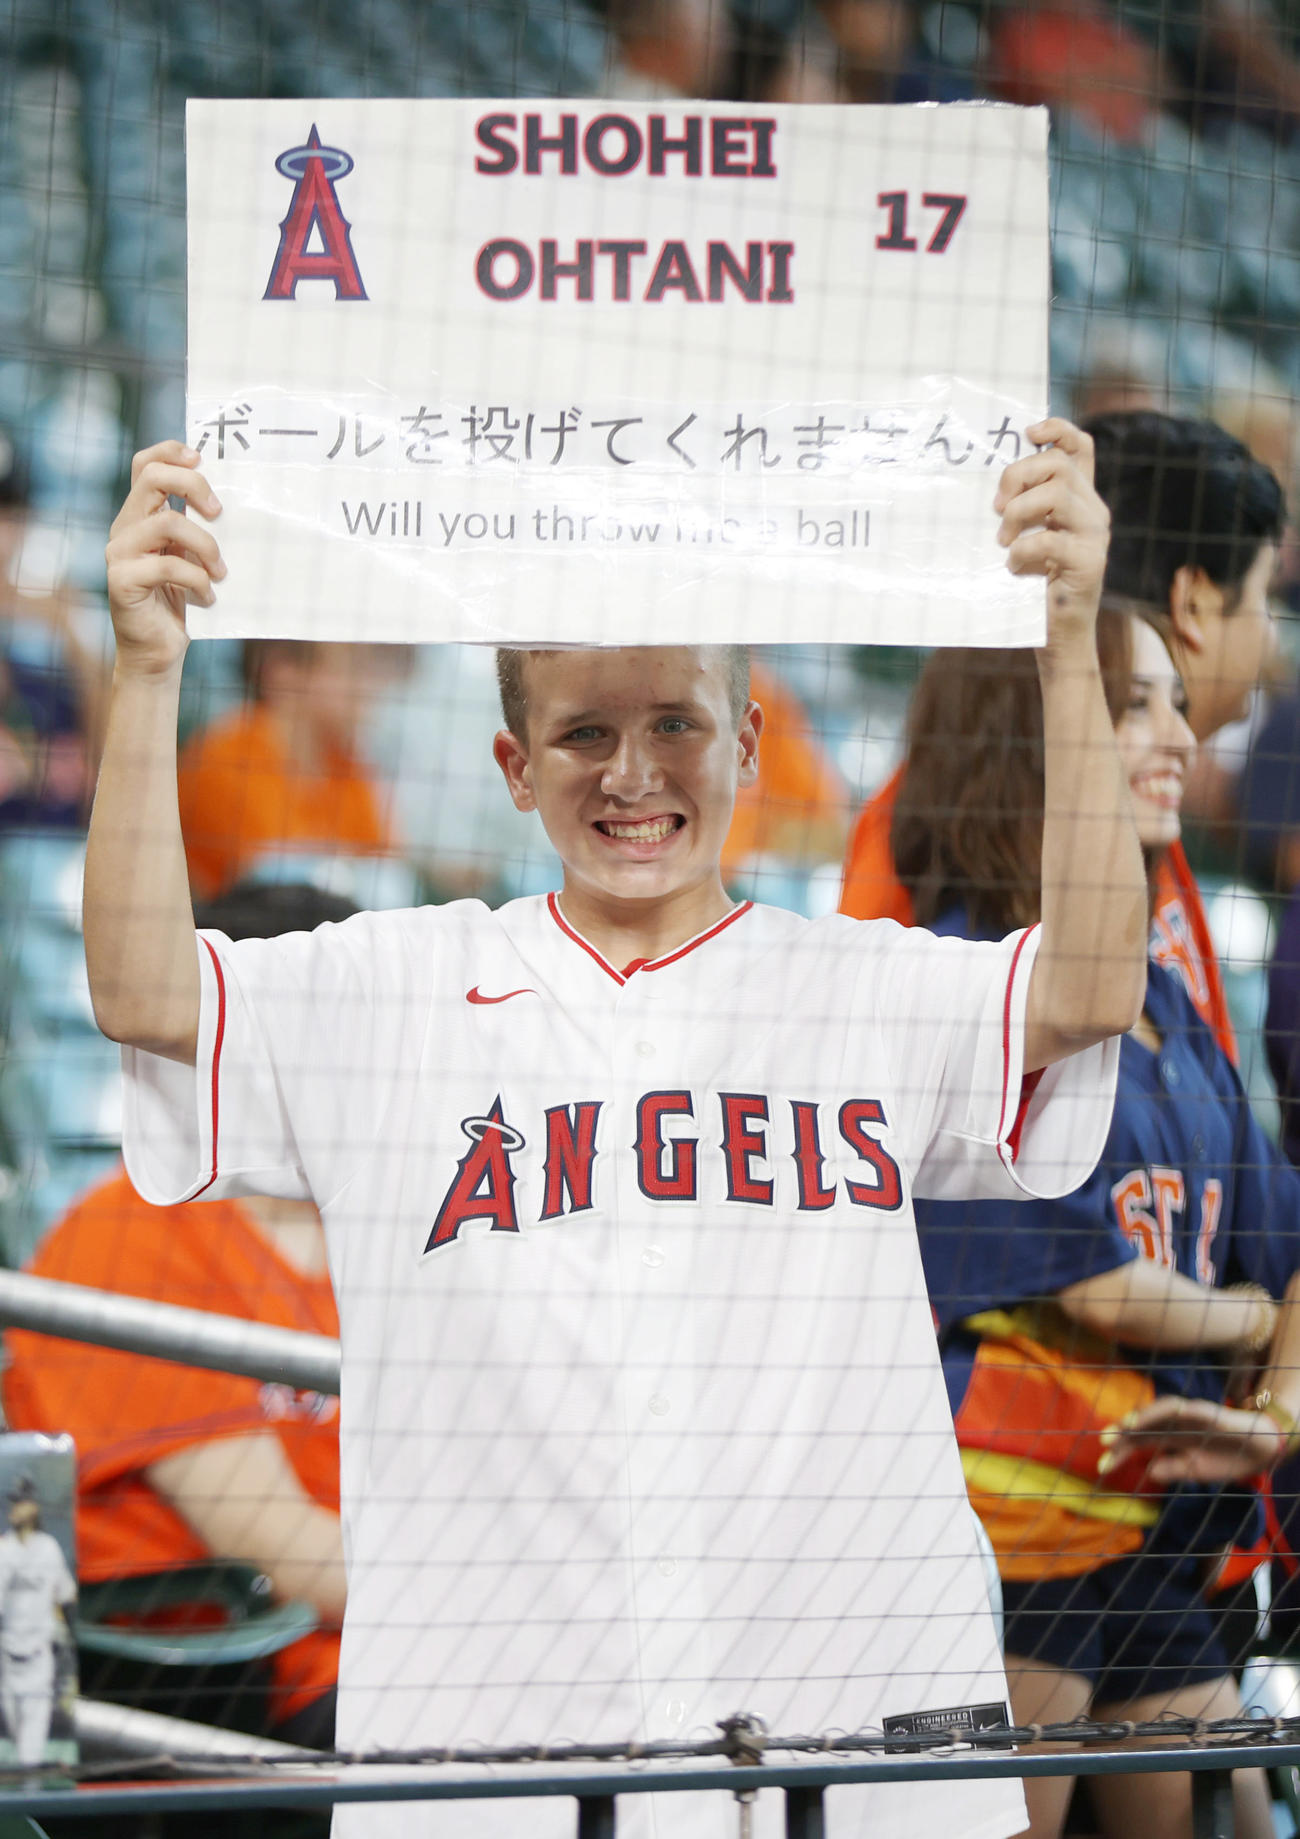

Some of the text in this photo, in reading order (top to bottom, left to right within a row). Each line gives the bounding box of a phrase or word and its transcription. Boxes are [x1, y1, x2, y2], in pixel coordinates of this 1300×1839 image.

[475, 113, 776, 178] SHOHEI
[875, 190, 967, 253] 17
[474, 237, 794, 304] OHTANI
[341, 501, 421, 537] Will
[439, 512, 515, 546] you
[532, 505, 660, 542] throw
[799, 510, 870, 547] ball
[423, 1089, 905, 1256] ANGELS
